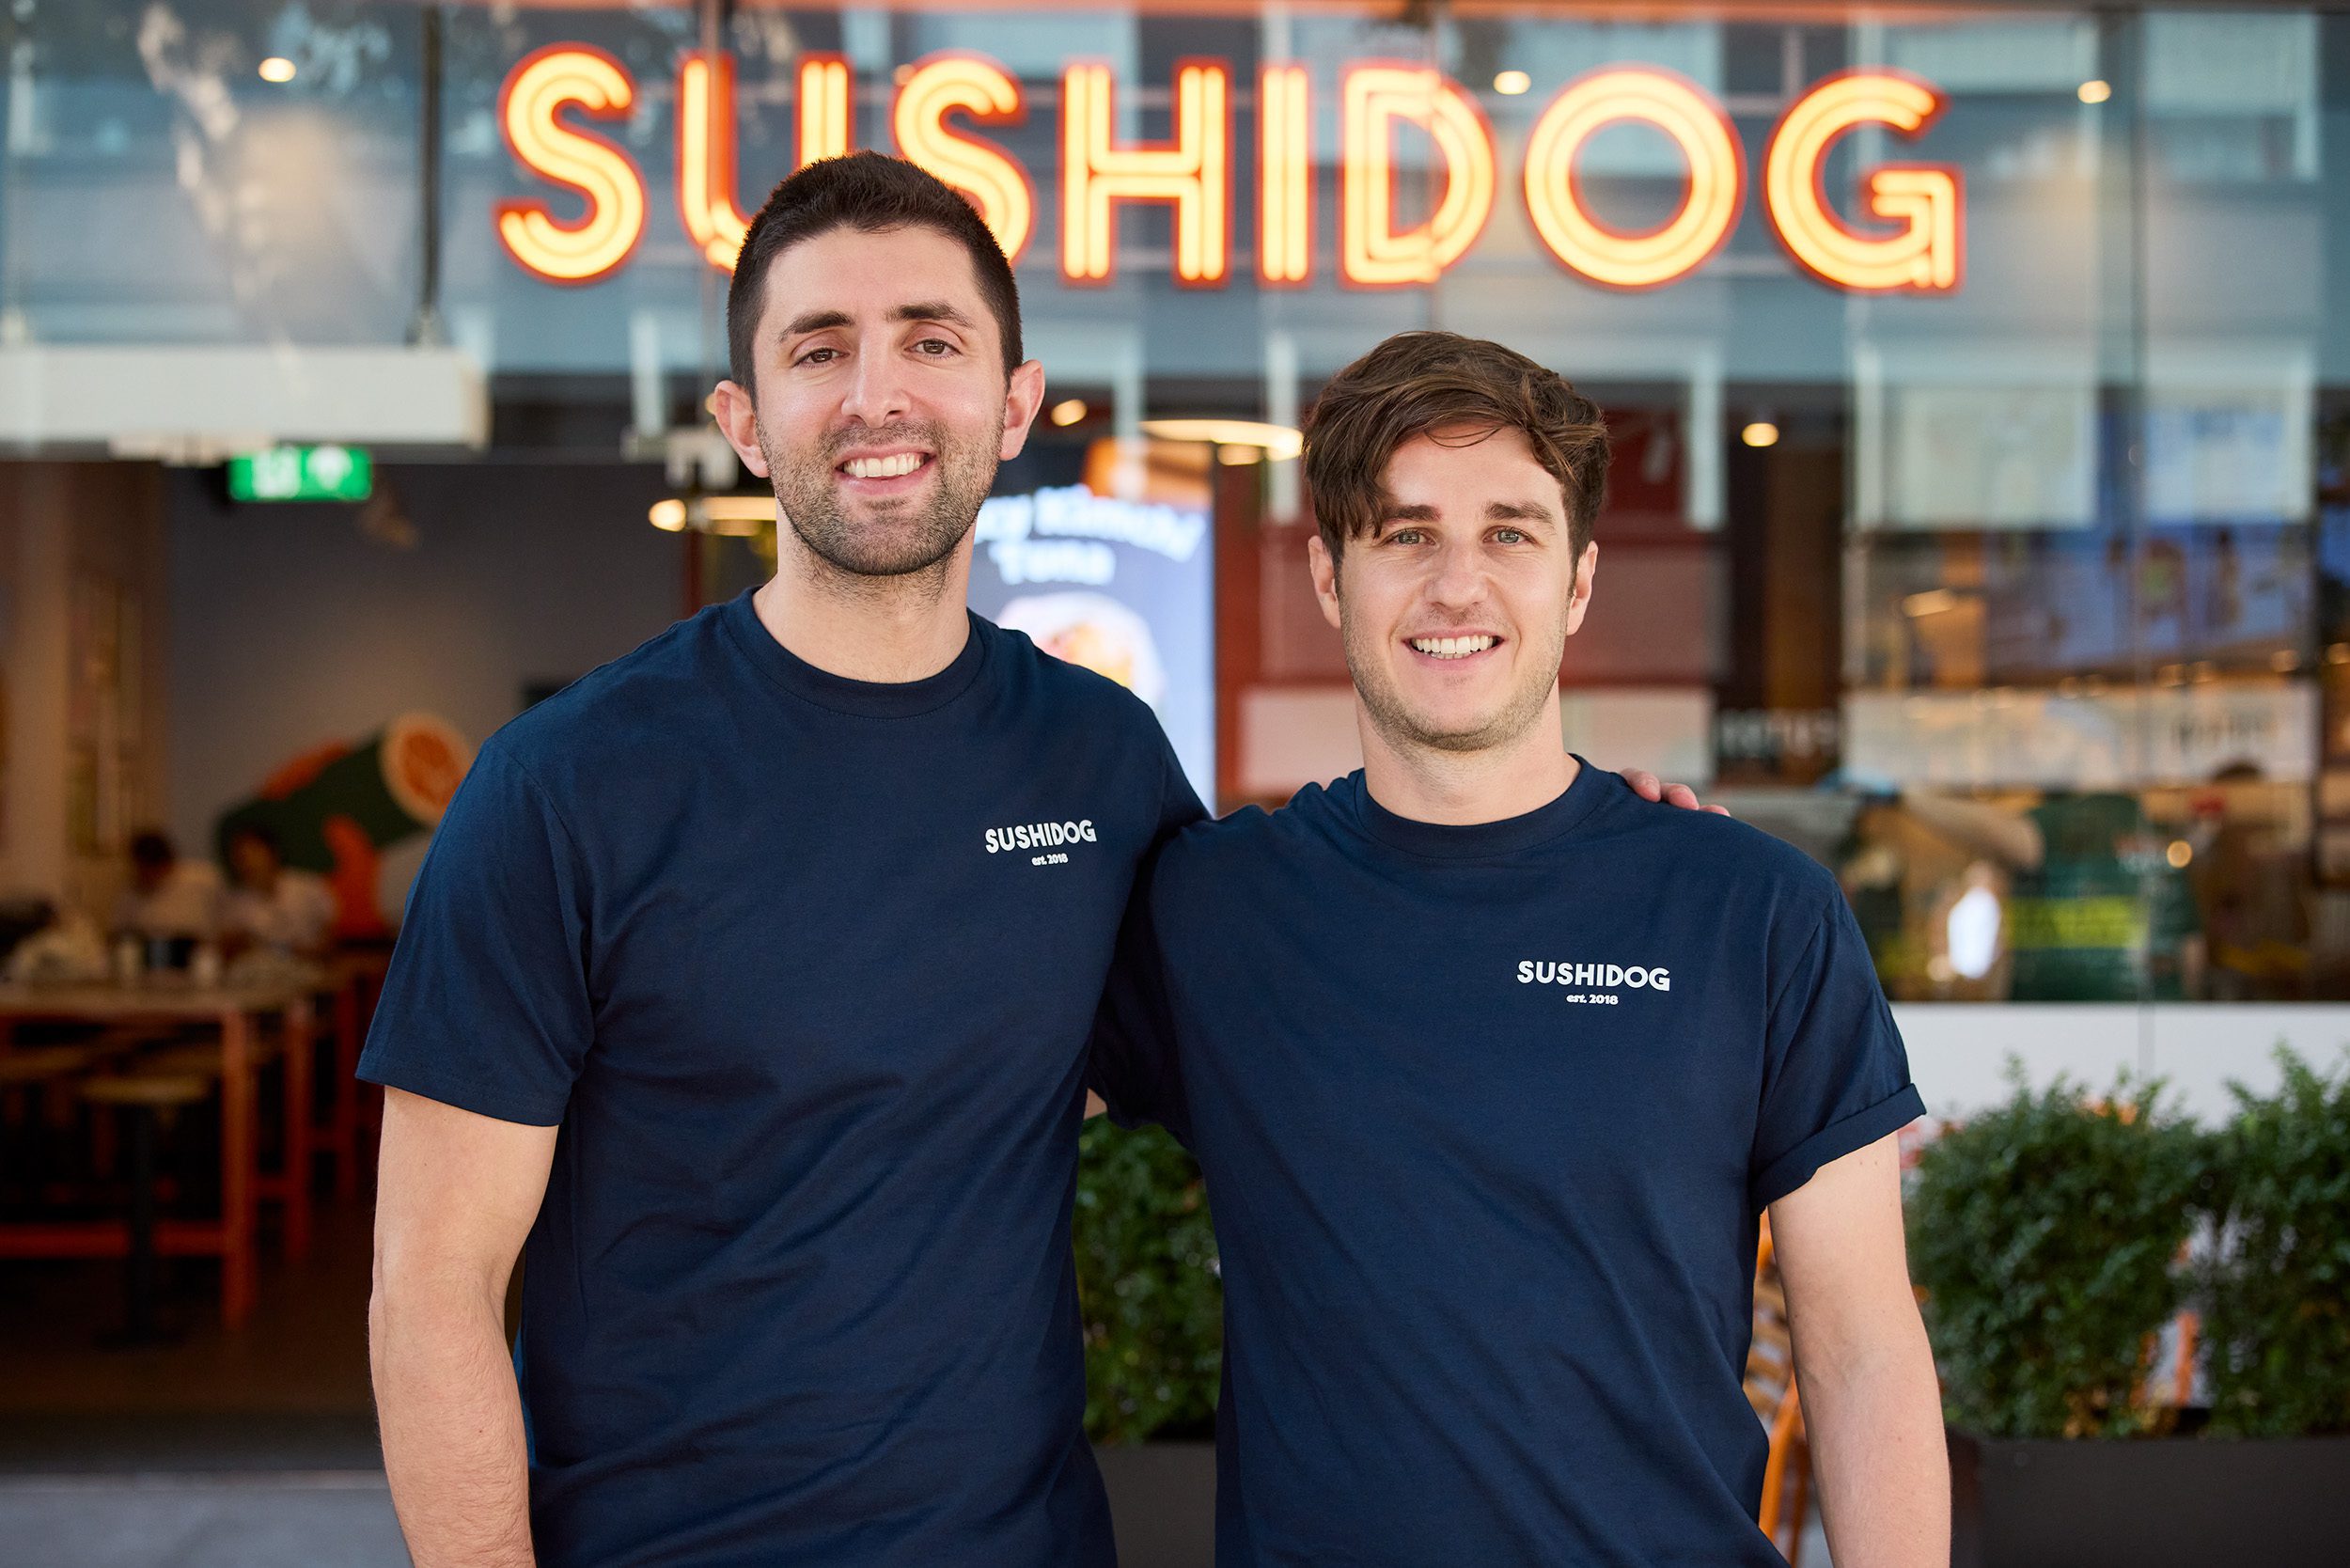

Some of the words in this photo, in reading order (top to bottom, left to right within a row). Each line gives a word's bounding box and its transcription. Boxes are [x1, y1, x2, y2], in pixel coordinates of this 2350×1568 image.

[495, 41, 1966, 296] SUSHIDOG
[985, 819, 1097, 854] SUSHIDOG
[1031, 855, 1047, 866] est.
[1048, 853, 1069, 865] 2018
[1516, 960, 1670, 992] SUSHIDOG
[1566, 994, 1587, 1004] est.
[1589, 994, 1619, 1005] 2018
